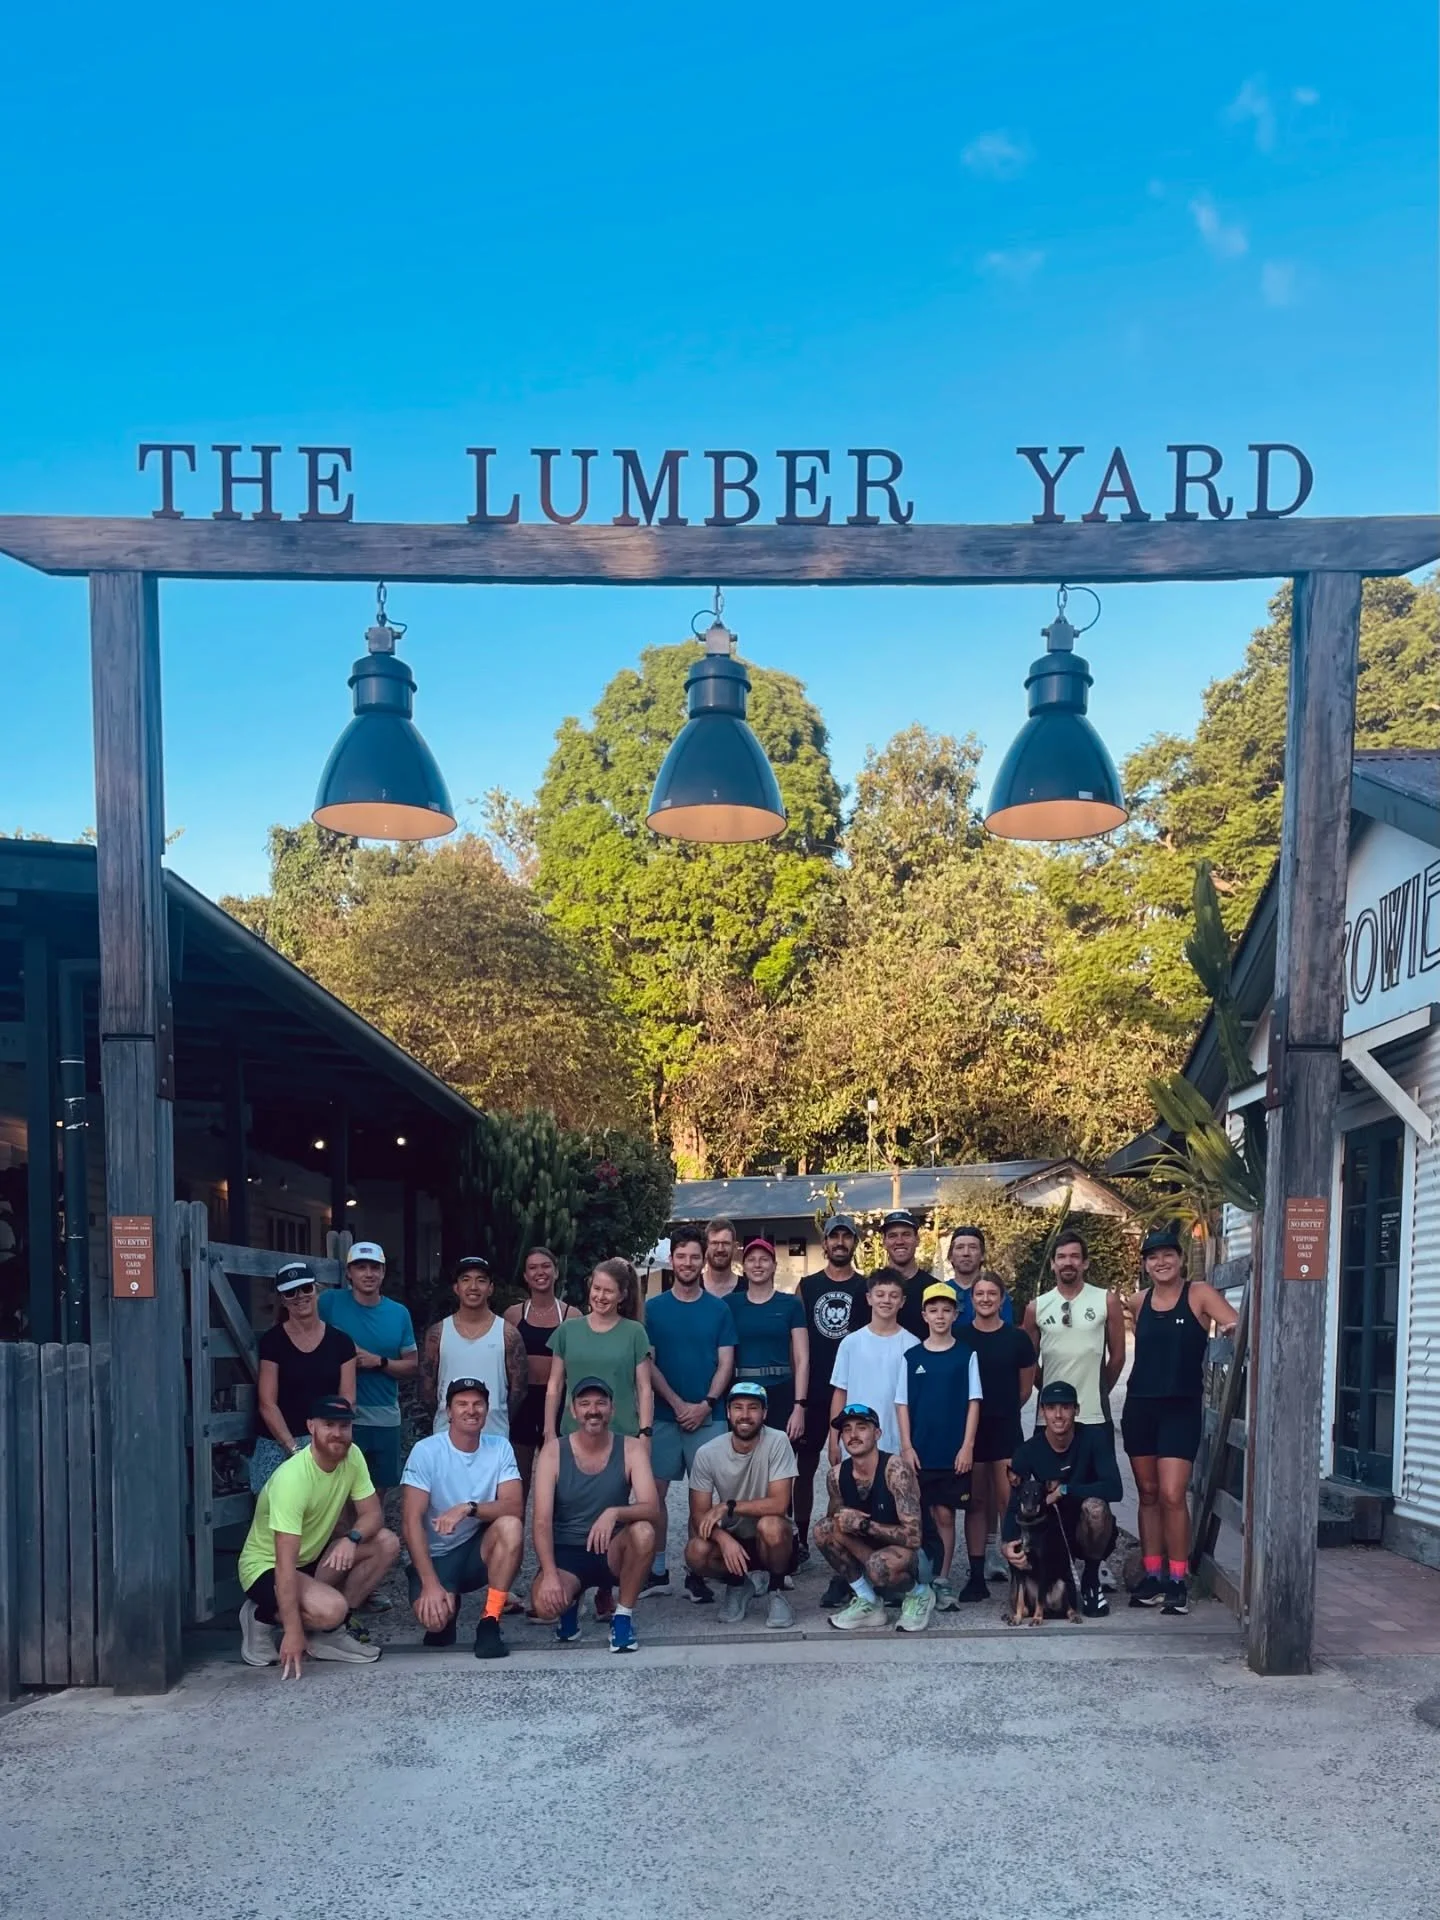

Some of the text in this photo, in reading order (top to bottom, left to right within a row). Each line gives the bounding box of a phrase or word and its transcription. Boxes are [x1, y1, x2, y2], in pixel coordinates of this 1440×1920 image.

[138, 443, 1314, 526] THE LUMBER YARD
